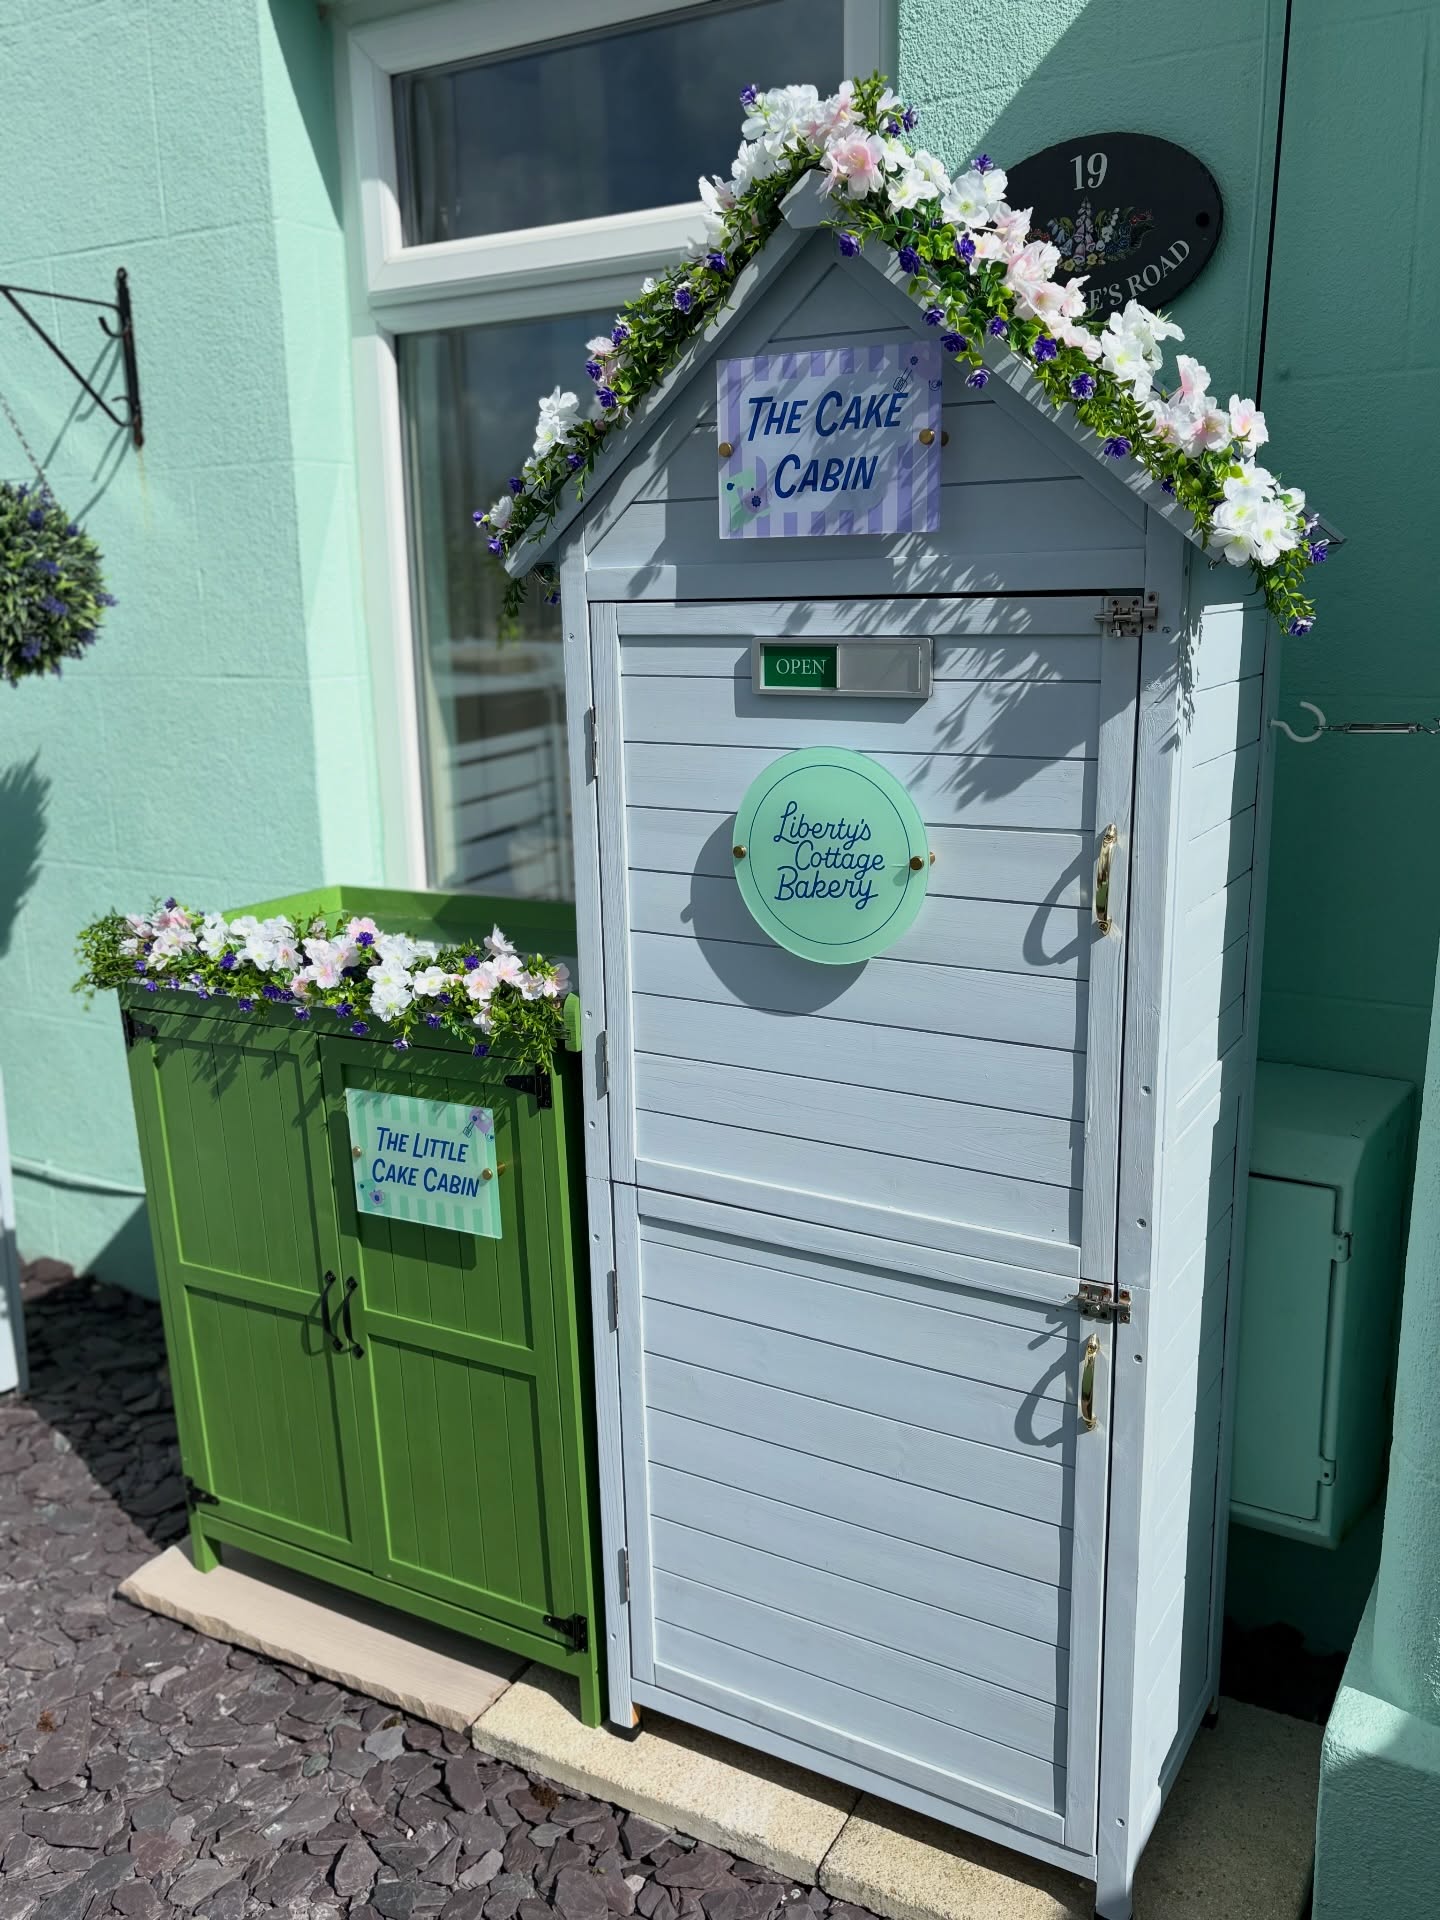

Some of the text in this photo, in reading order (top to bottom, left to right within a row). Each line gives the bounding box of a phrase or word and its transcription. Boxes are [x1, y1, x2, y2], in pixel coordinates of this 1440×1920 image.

[1070, 152, 1108, 190] 19
[1126, 239, 1190, 299] ROAD
[747, 390, 908, 441] THE CAKE
[774, 453, 879, 498] CABIN
[775, 658, 826, 675] OPEN
[773, 800, 872, 849] Liberty's
[795, 840, 885, 880] Cottage
[774, 866, 879, 910] Bakery
[376, 1126, 469, 1163] THE LITTLE
[372, 1158, 480, 1197] CAKE CABIN
